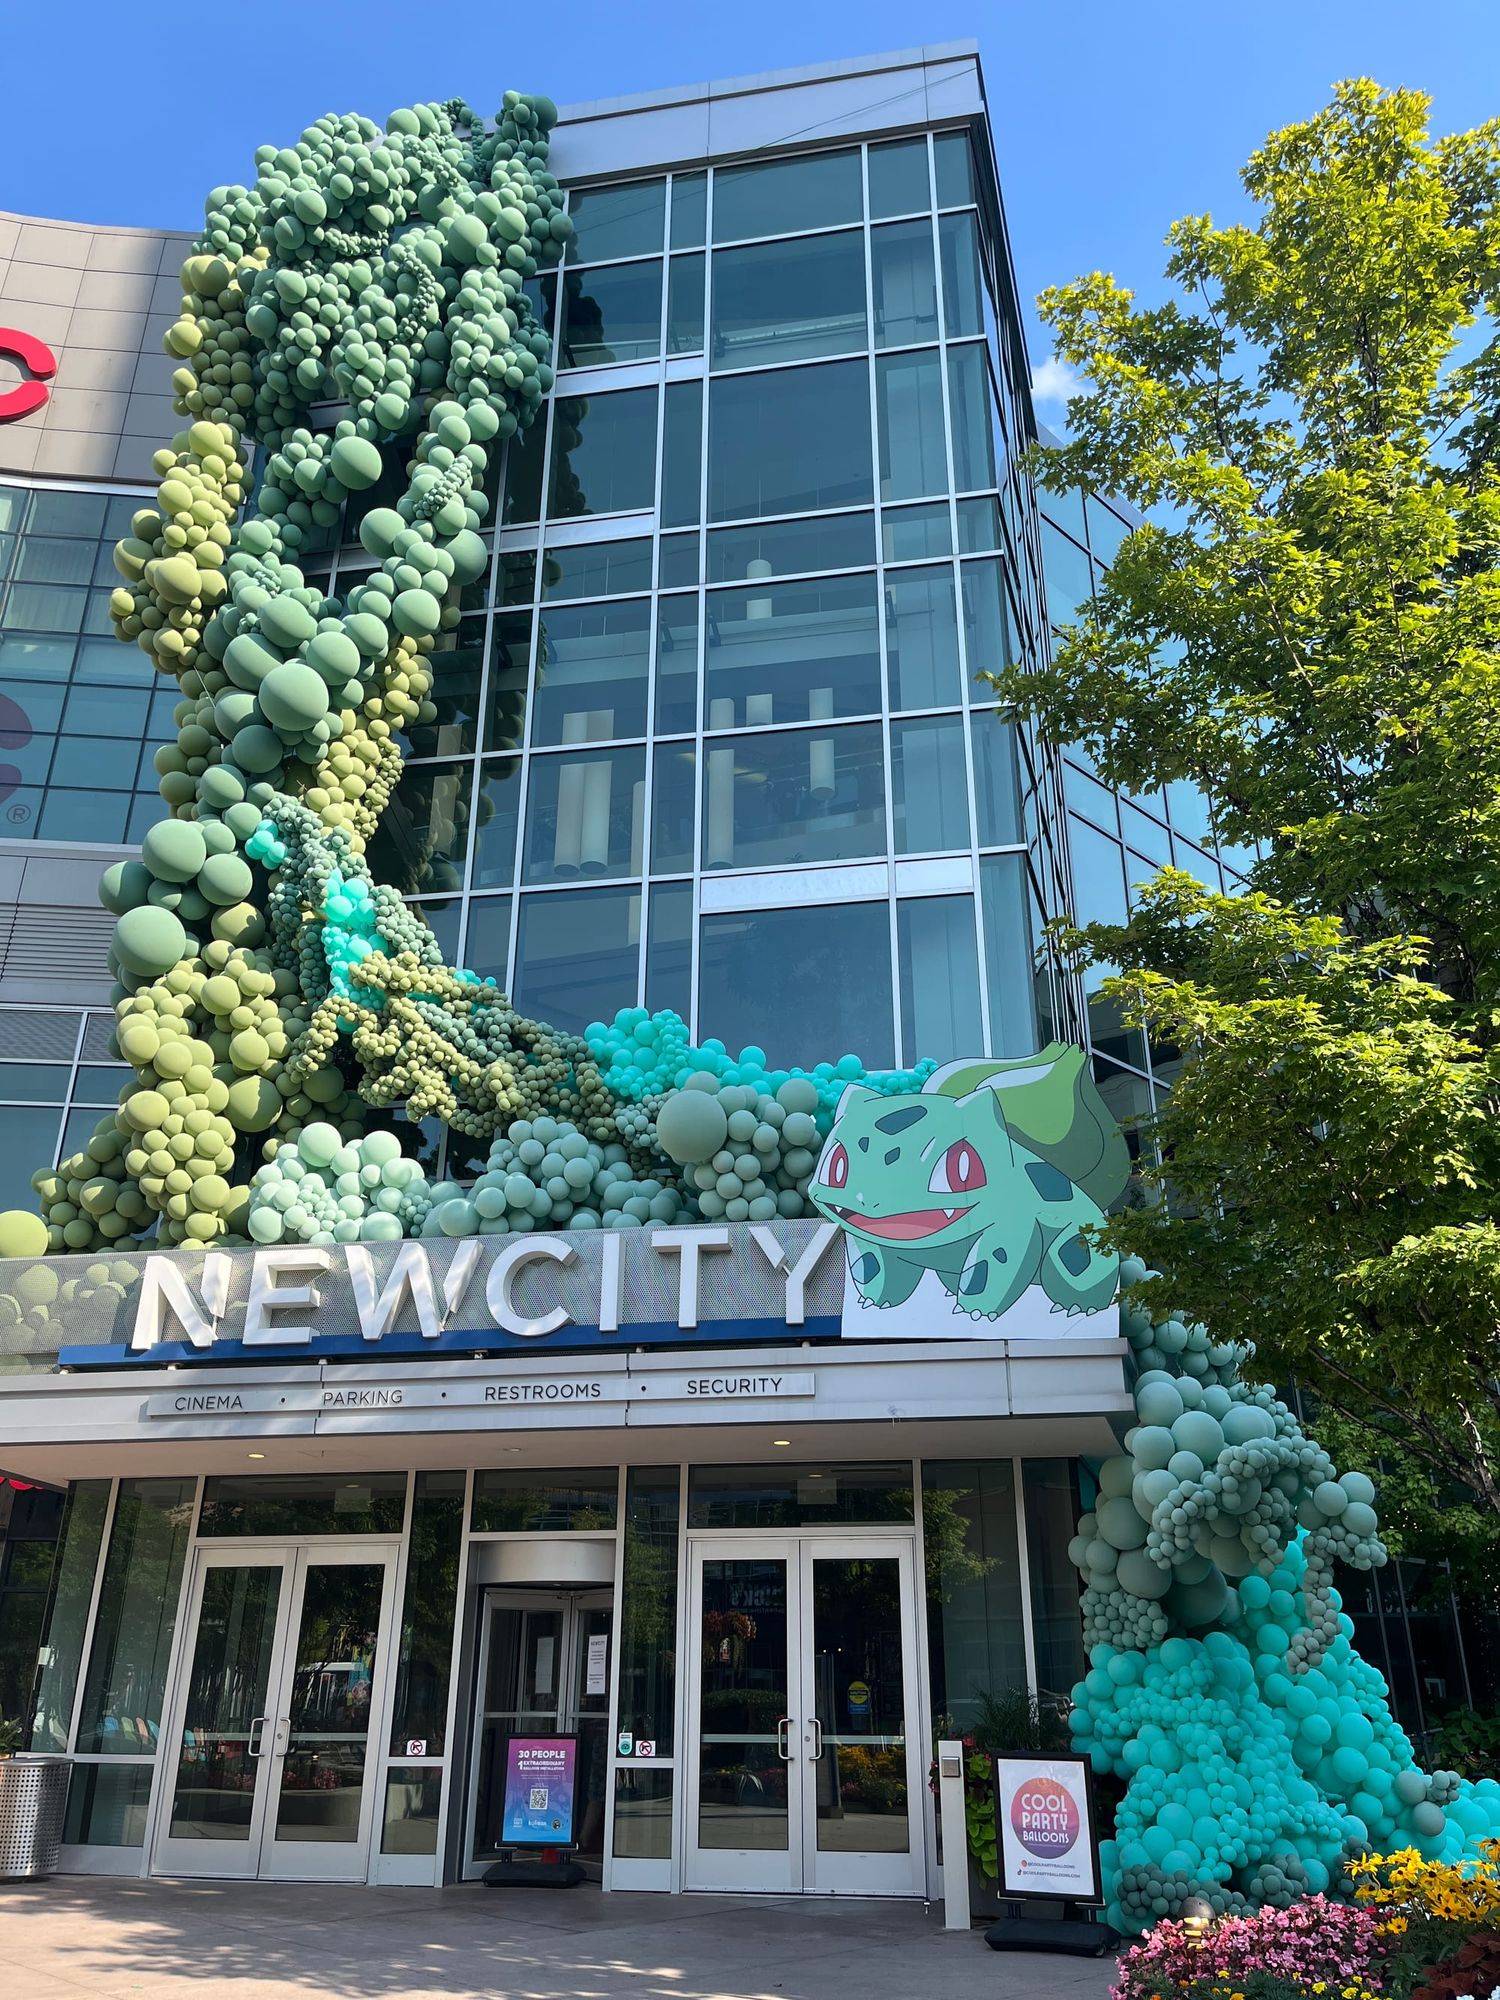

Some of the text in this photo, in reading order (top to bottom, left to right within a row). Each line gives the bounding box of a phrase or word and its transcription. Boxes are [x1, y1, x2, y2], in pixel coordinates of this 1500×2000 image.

[131, 1222, 843, 1350] NEWCITY
[174, 1377, 783, 1411] CINEMA PARKING RESTROOMS SECURITY
[518, 1750, 566, 1759] 30 PEOPLE
[517, 1760, 523, 1770] 1
[1021, 1793, 1067, 1812] COOL
[1022, 1812, 1068, 1830] PARTY
[1023, 1830, 1069, 1843] BALLOONS
